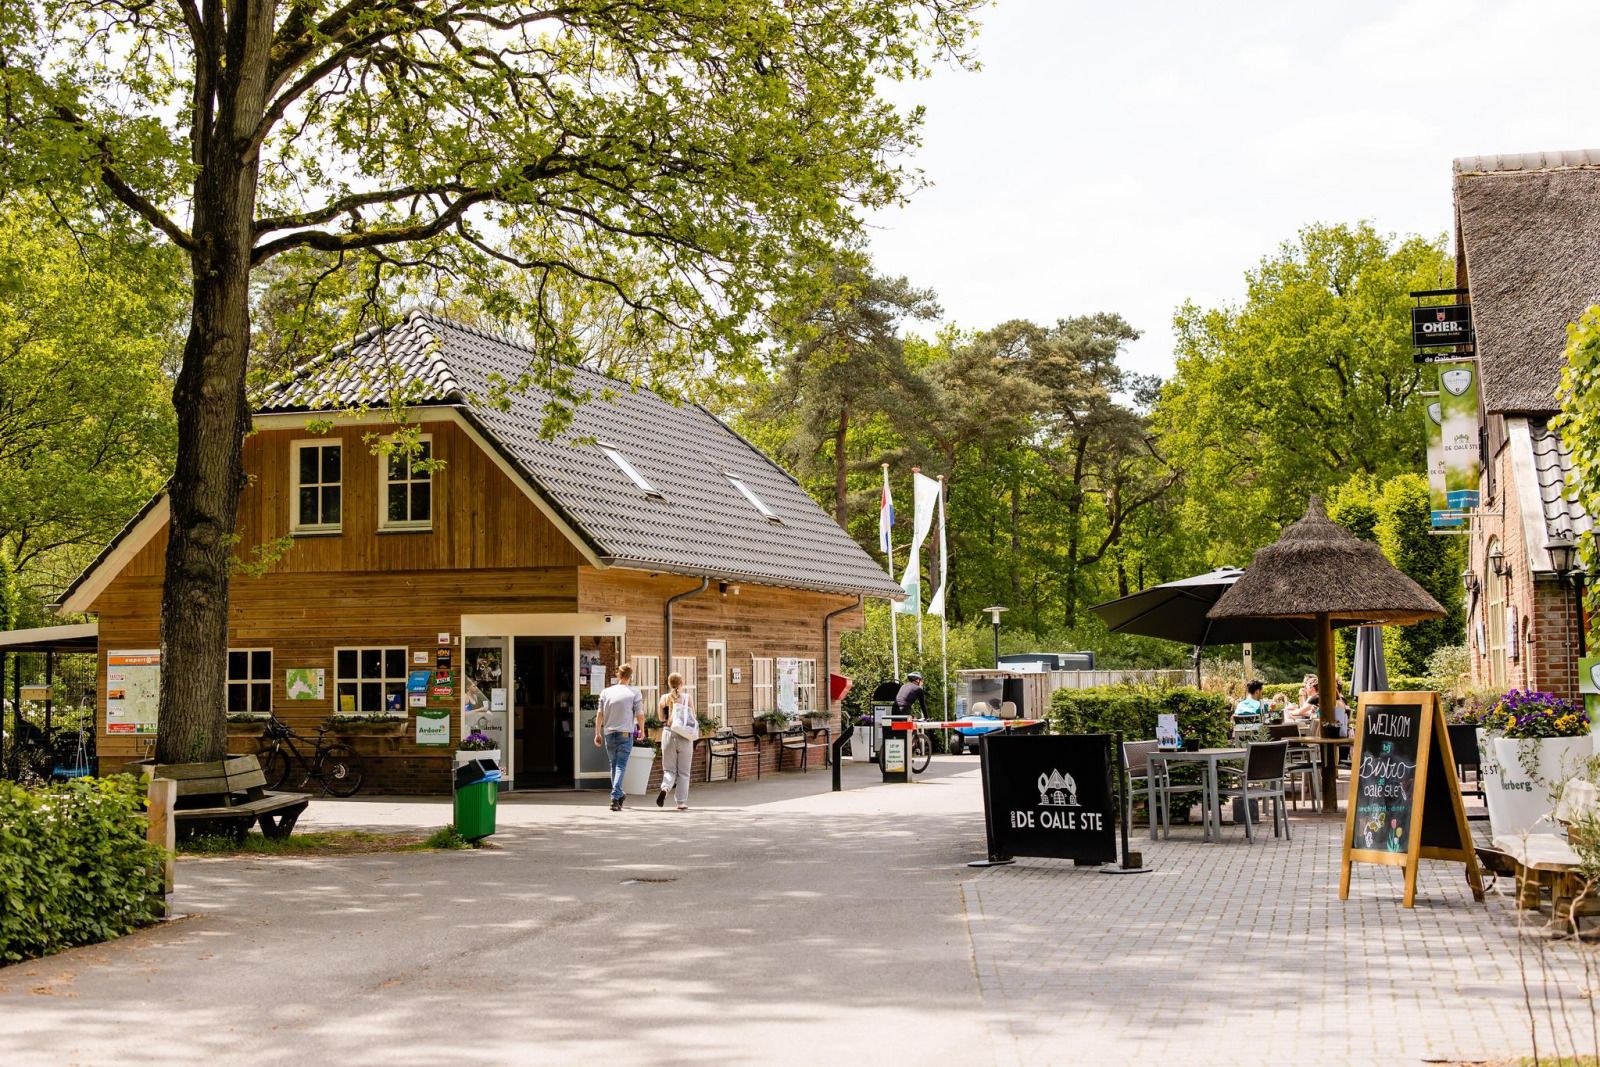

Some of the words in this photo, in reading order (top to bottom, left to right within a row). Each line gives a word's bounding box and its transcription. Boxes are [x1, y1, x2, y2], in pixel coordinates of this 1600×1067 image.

[1422, 321, 1462, 333] OMER.
[1368, 714, 1410, 737] WELKOM
[1360, 756, 1416, 778] Bistro
[1017, 811, 1035, 828] DE
[1040, 811, 1076, 829] OALE
[1080, 812, 1102, 830] STE
